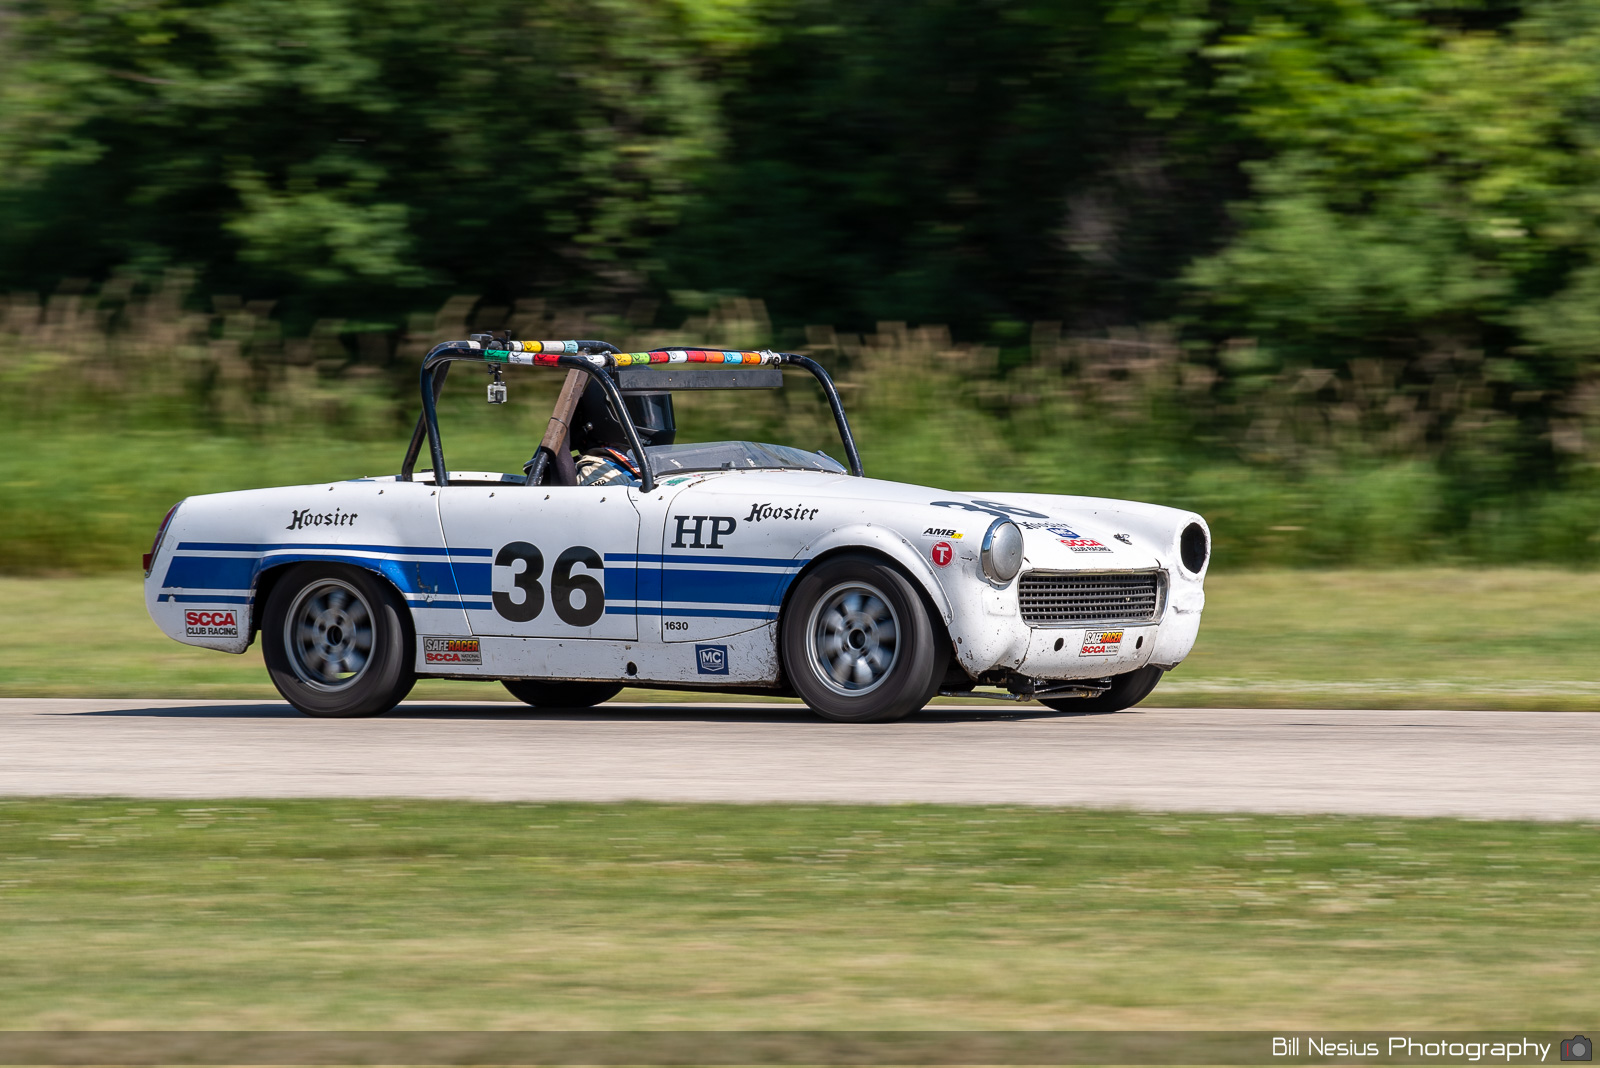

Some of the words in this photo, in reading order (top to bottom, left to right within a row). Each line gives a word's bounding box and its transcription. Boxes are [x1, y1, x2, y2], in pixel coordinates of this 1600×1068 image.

[743, 503, 819, 522] Hoosier
[930, 500, 1050, 519] 36
[286, 507, 358, 530] Hoosier
[671, 515, 737, 549] HP
[923, 527, 956, 536] AMB
[1060, 539, 1104, 547] SCCA
[936, 545, 949, 563] T
[492, 541, 605, 627] 36
[186, 611, 236, 627] SCCA
[187, 627, 206, 635] CLUB
[207, 627, 237, 635] RACING
[664, 621, 689, 631] 1630
[1085, 631, 1123, 644] SAFERACER
[426, 639, 479, 651] SAFERACER
[1081, 645, 1106, 654] SCCA
[426, 653, 461, 662] SCCA
[702, 651, 722, 663] MC
